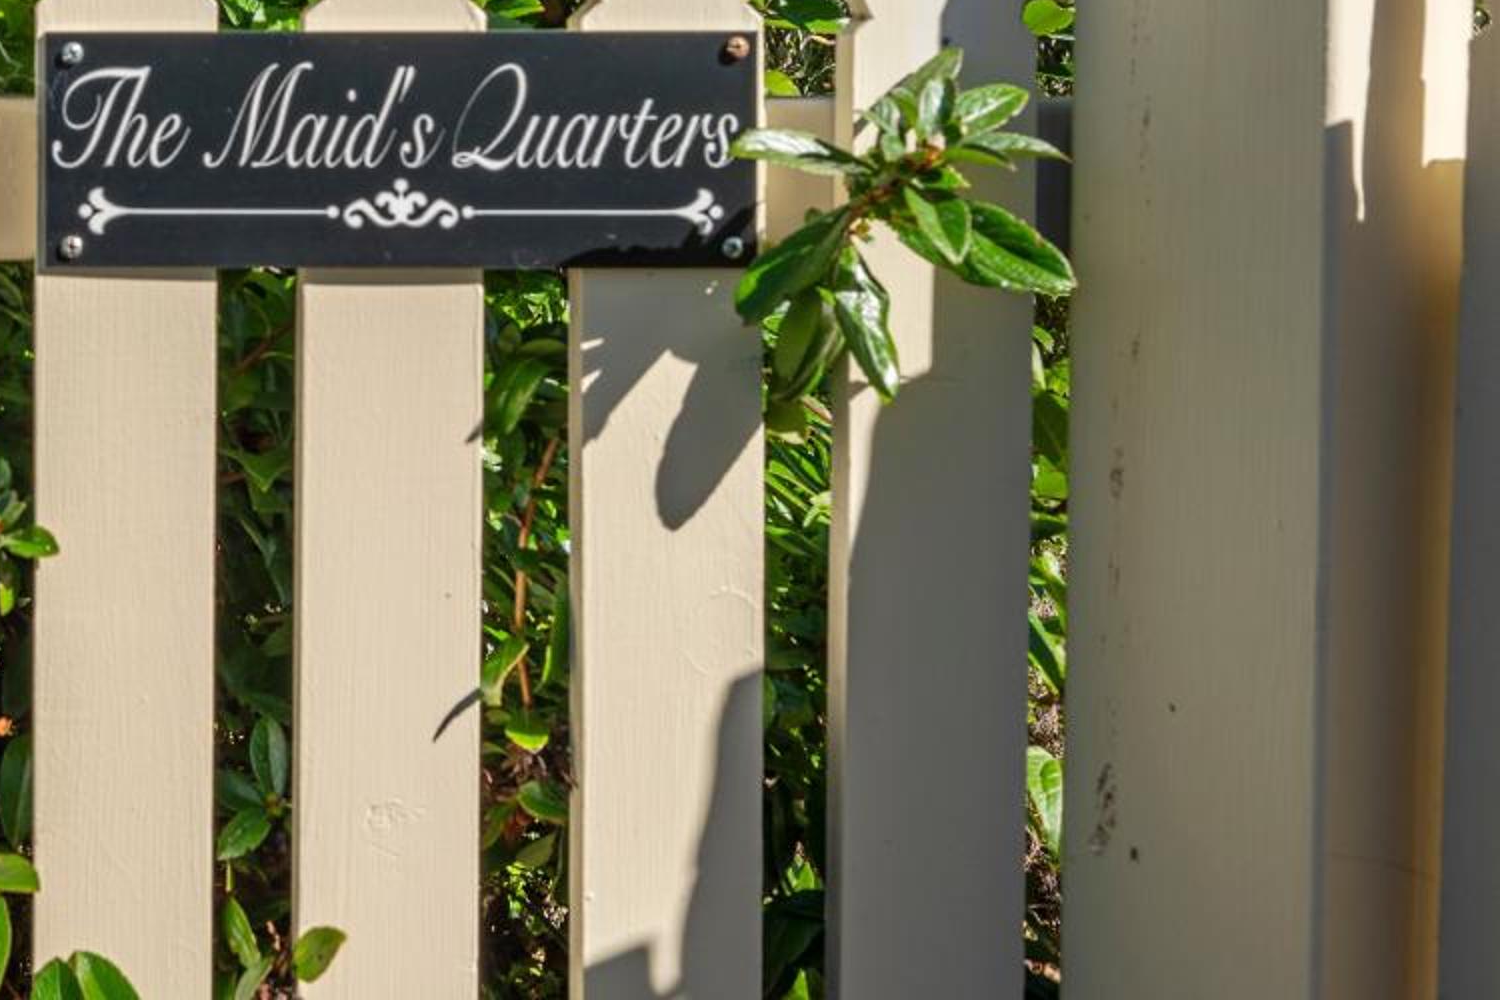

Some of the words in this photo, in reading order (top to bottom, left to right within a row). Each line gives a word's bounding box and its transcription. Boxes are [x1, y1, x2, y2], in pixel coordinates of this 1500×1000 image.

[52, 65, 191, 169] The
[202, 61, 447, 169] Maid's
[451, 62, 740, 170] Quarters
